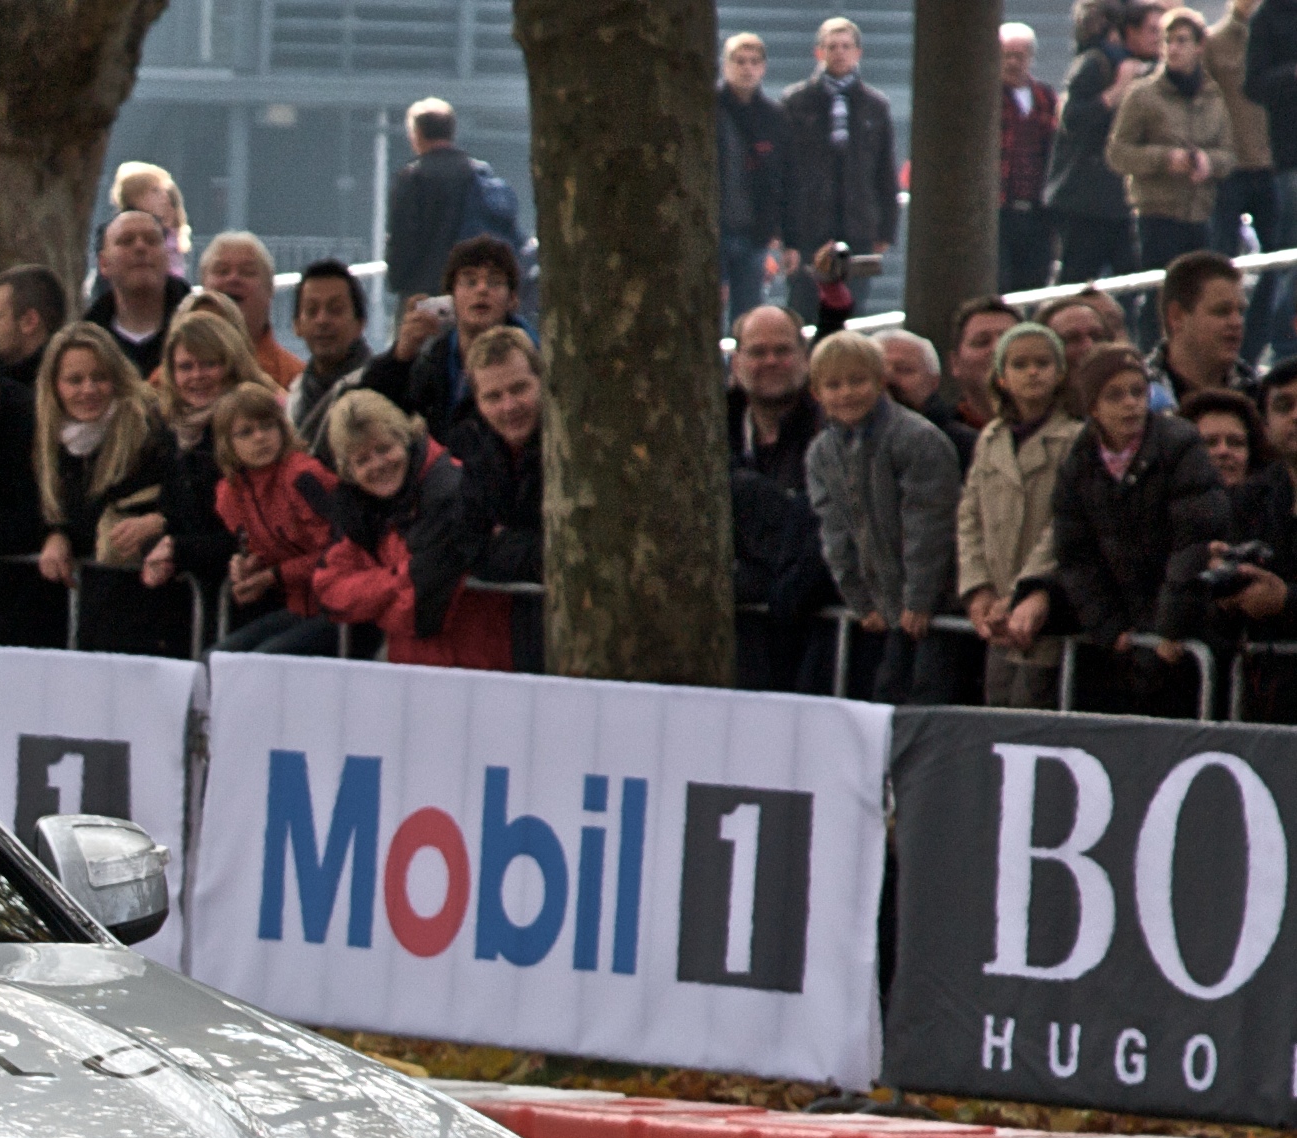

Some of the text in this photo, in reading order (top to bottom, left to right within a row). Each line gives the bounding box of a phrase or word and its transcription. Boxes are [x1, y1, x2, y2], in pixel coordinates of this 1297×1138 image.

[258, 749, 761, 976] Mobil 1
[981, 1013, 1218, 1092] HUGO
